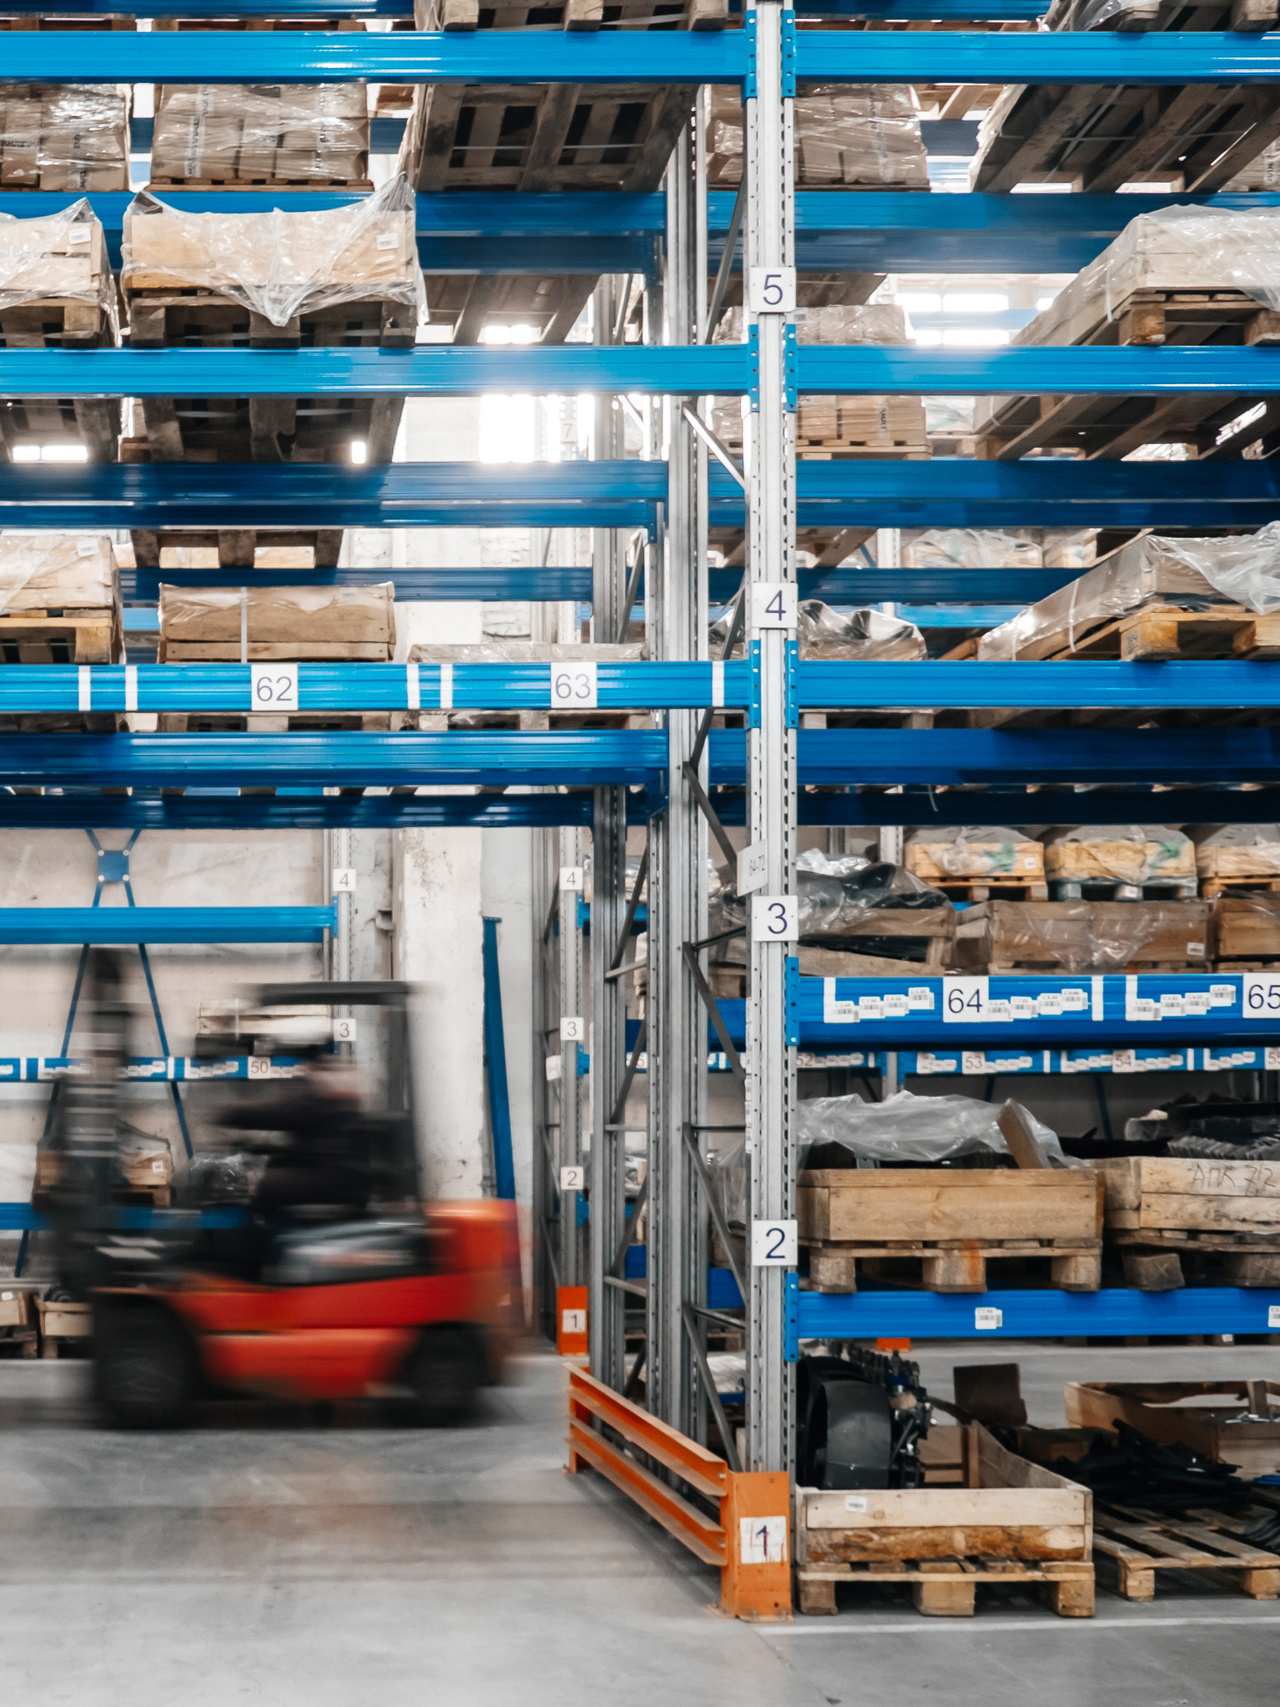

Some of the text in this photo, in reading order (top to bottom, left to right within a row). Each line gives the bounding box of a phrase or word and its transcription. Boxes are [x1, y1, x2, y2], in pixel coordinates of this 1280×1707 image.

[764, 275, 783, 305] 5
[765, 590, 786, 621] 4
[257, 677, 292, 701] 62
[556, 674, 590, 699] 63
[340, 873, 349, 887] 4
[567, 872, 576, 885] 4
[768, 903, 787, 934] 3
[948, 988, 983, 1014] 64
[1249, 985, 1280, 1009] 65
[340, 1023, 350, 1038] 3
[568, 1022, 577, 1036] 3
[251, 1061, 268, 1073] 50
[965, 1056, 982, 1069] 53
[568, 1171, 577, 1186] 2
[766, 1228, 785, 1259] 2
[572, 1314, 577, 1328] 1
[756, 1526, 768, 1557] 1
